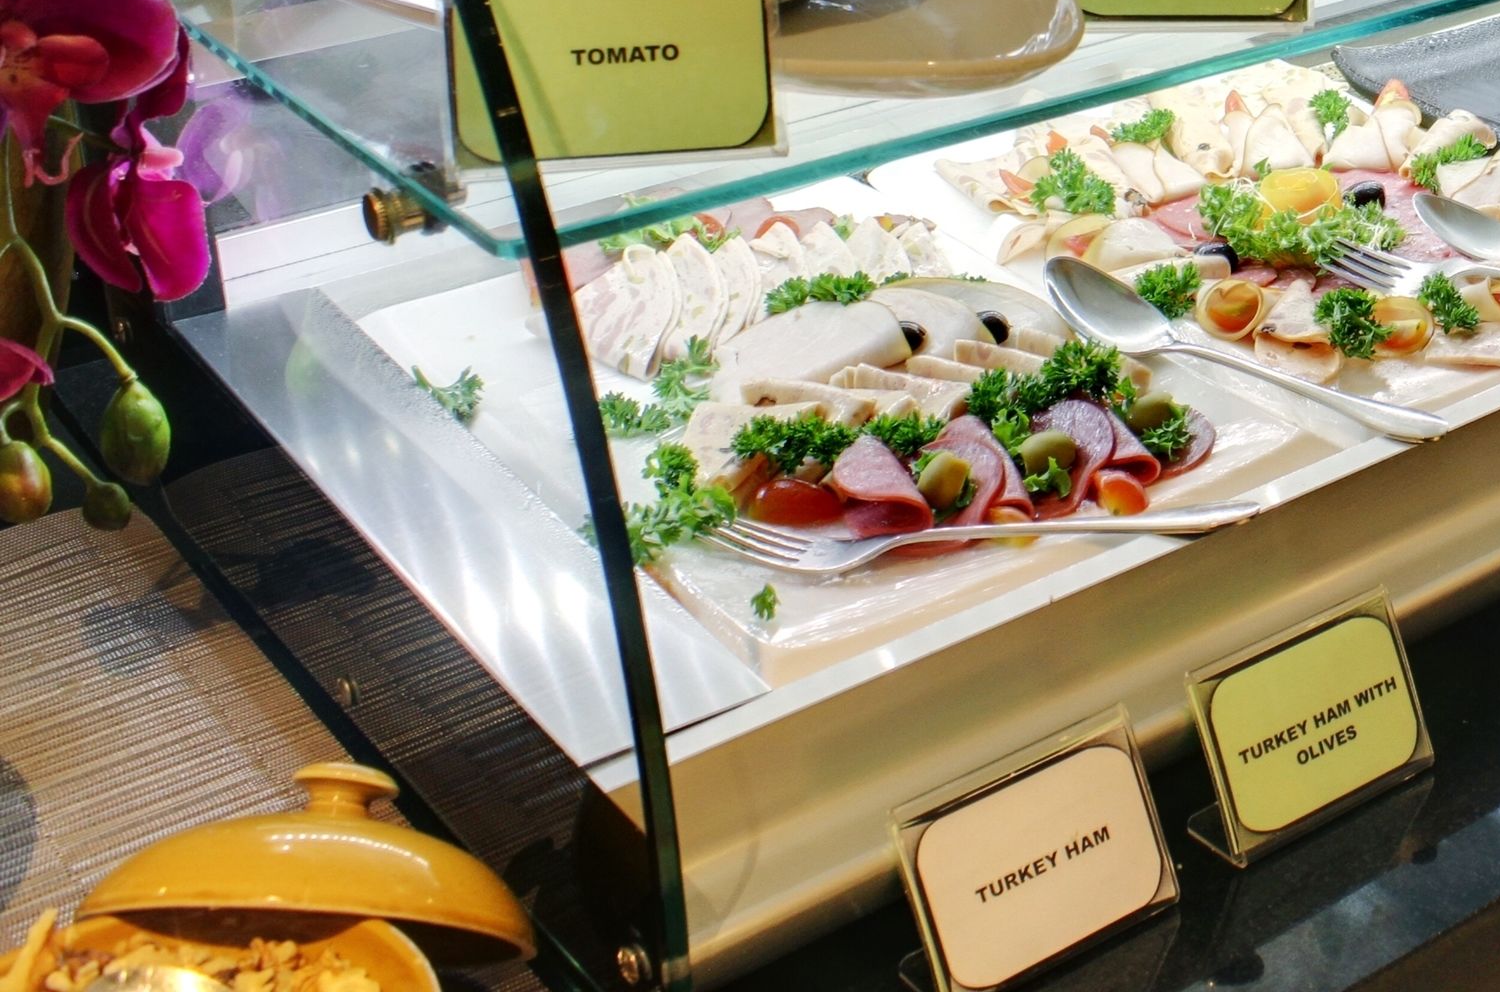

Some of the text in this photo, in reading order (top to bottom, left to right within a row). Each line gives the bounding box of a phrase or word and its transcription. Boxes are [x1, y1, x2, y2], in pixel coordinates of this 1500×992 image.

[571, 43, 680, 66] TOMATO
[1238, 675, 1398, 765] TURKEY HAM WITH
[1296, 724, 1358, 766] OLIVES
[974, 825, 1111, 904] TURKEY HAM
